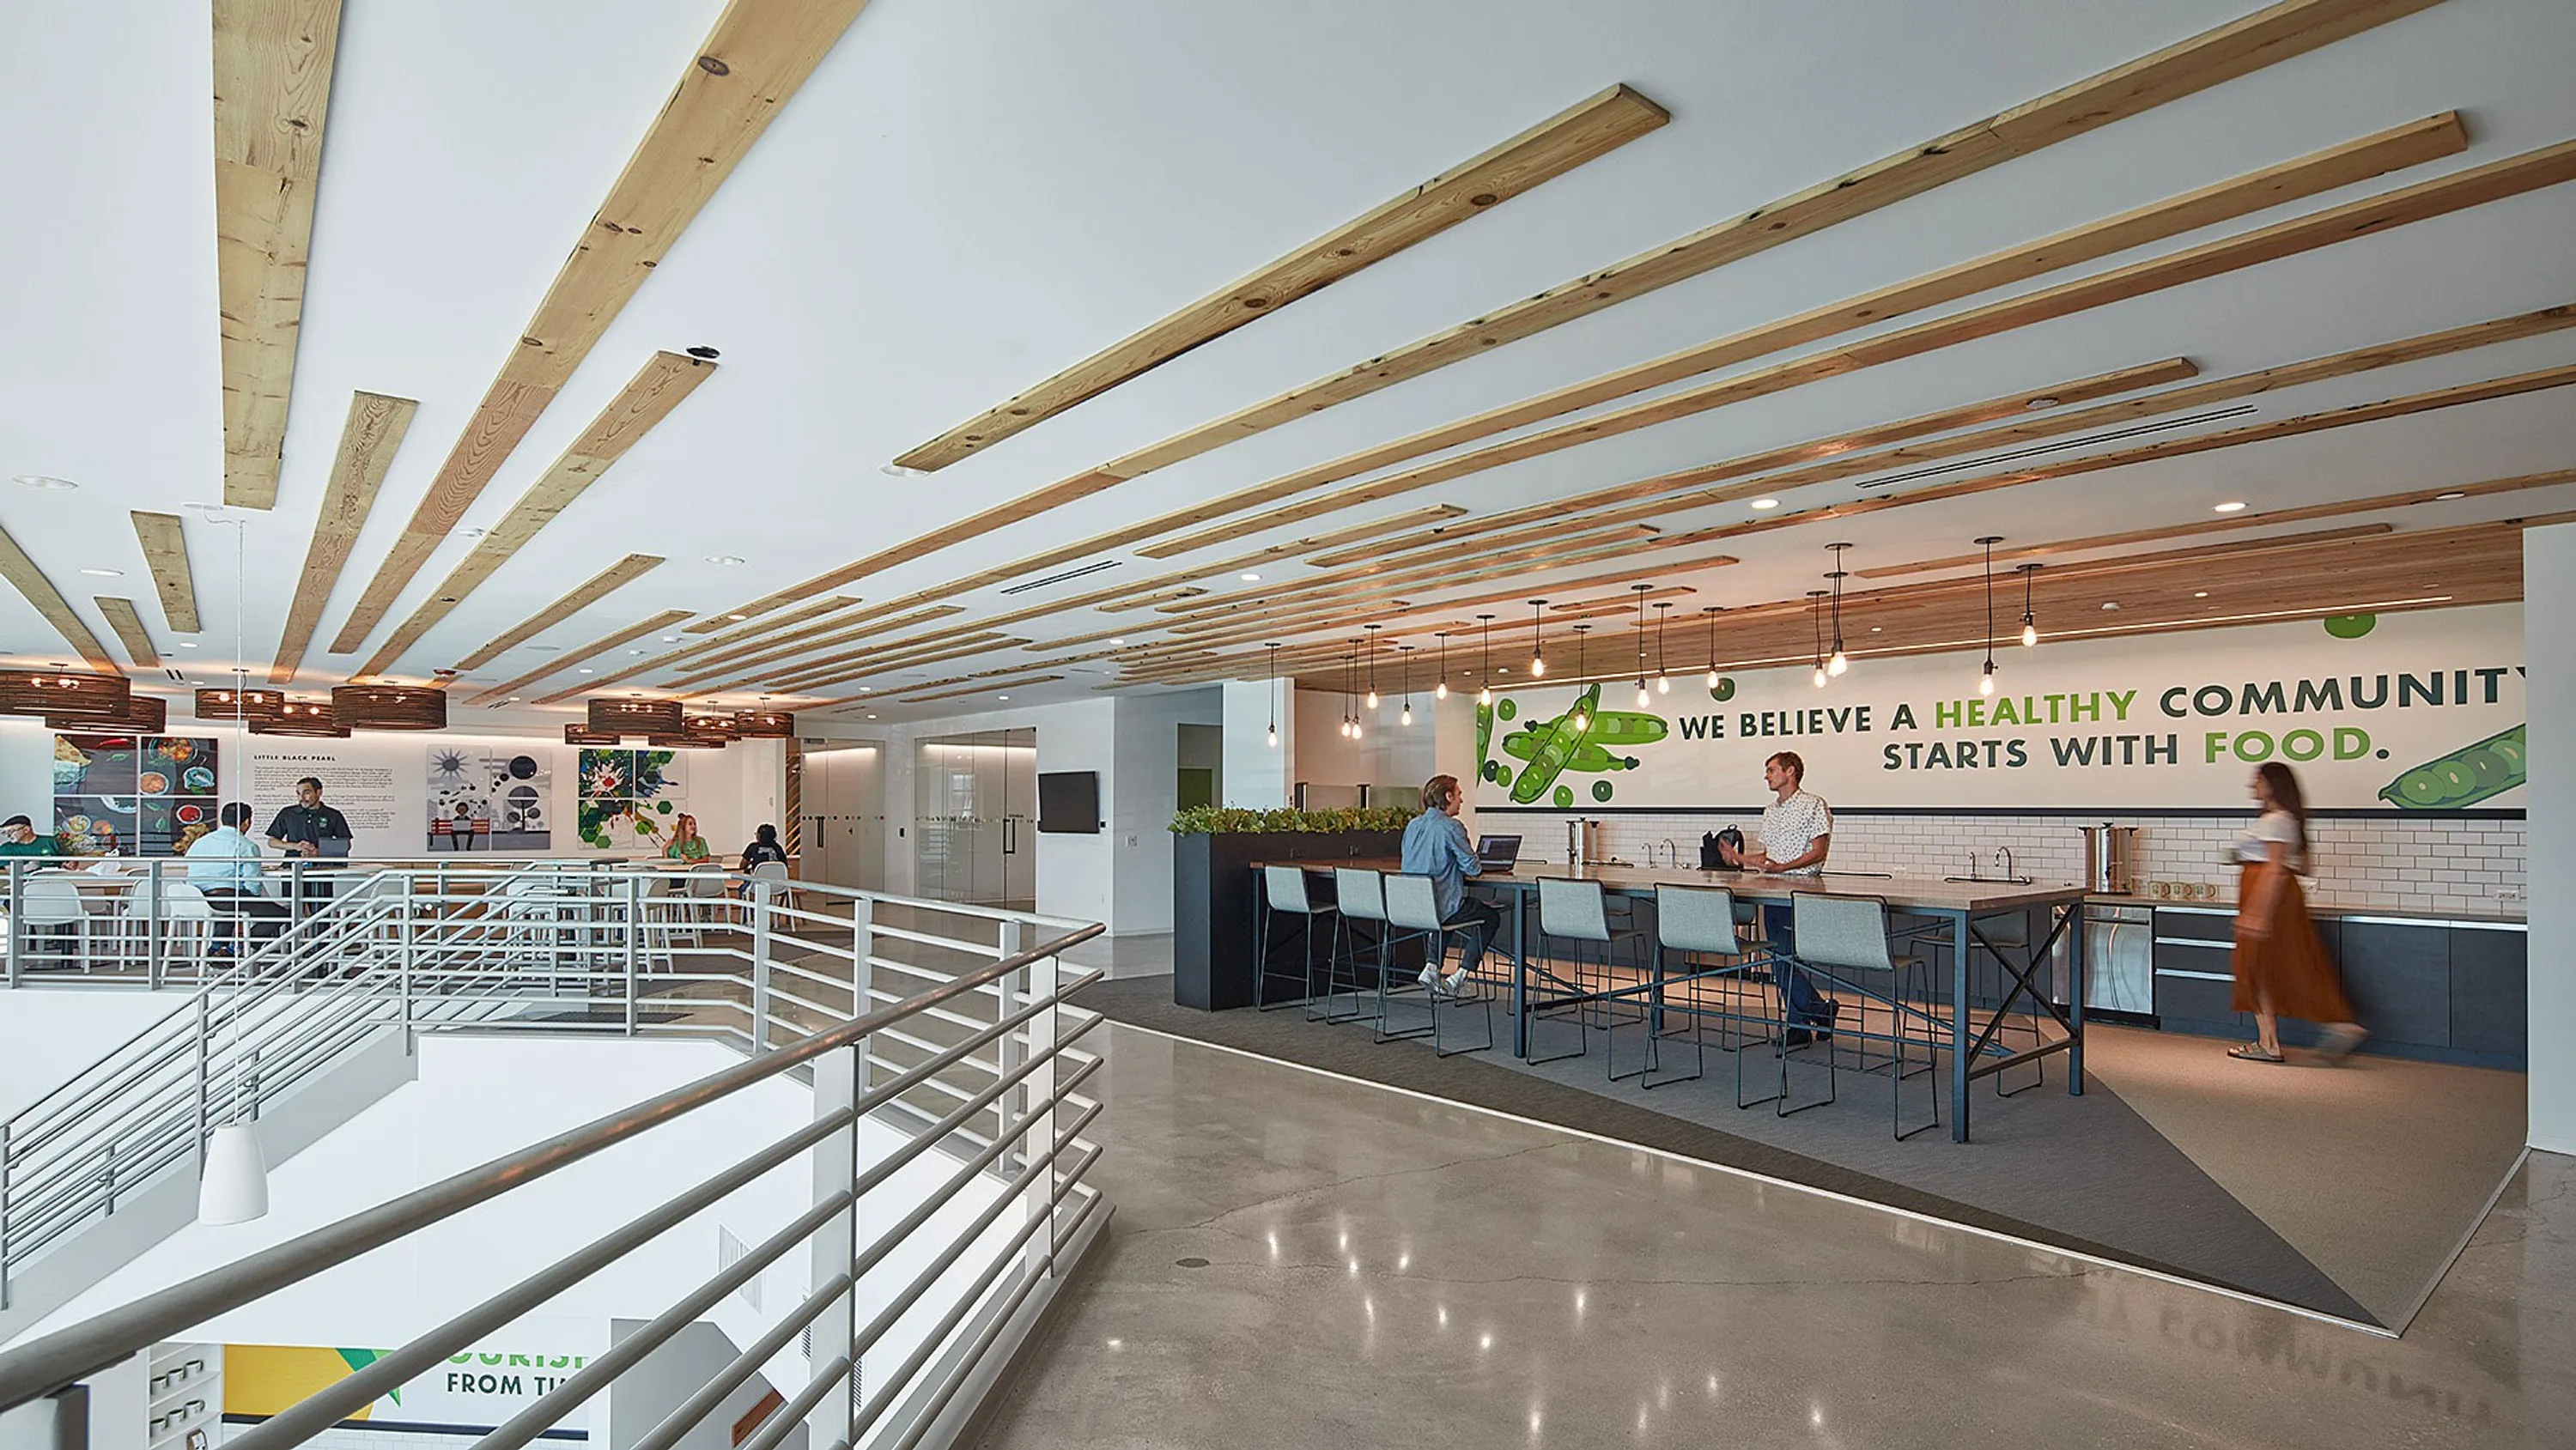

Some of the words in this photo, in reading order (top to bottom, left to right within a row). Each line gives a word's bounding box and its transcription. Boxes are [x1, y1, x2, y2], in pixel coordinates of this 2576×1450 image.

[1679, 715, 1725, 739] WE
[1741, 706, 1872, 737] BELIEVE
[1890, 704, 1917, 730] A
[1935, 690, 2137, 728] HEALTHY
[2160, 667, 2526, 718] COMMUNIT
[1883, 739, 2028, 769] STARTS
[2050, 734, 2178, 766] WITH
[2205, 727, 2390, 762] FOOD.
[447, 1373, 522, 1395] FROM
